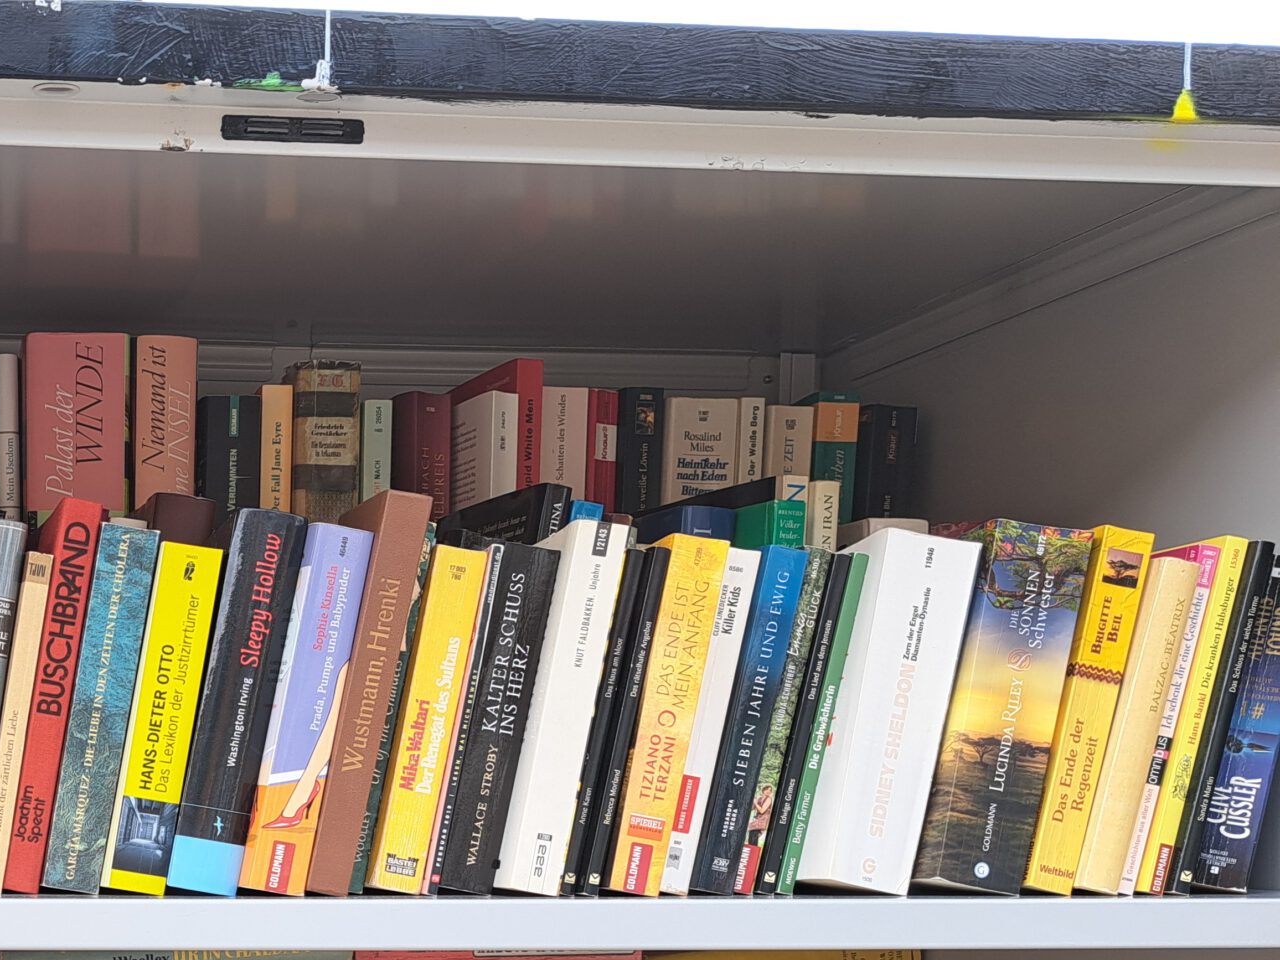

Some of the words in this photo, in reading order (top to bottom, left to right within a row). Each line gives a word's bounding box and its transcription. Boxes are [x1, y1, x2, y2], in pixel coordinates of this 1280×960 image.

[143, 345, 166, 365] ist
[45, 384, 74, 424] der
[75, 342, 103, 464] WINDE
[141, 369, 167, 472] Niemand
[5, 438, 14, 478] Usedom
[684, 431, 721, 442] Rosalind
[690, 442, 714, 452] Miles
[45, 428, 74, 497] Palast
[6, 479, 14, 502] Mein
[252, 533, 281, 603] Hollow
[37, 521, 90, 717] BUSCHBRAND
[172, 594, 200, 684] Justizirrtümer
[239, 609, 271, 667] Sleepy
[1090, 596, 1113, 654] BRIGITTE
[1106, 613, 1123, 642] BEIL
[482, 655, 510, 732] KALTER
[498, 572, 525, 647] SCHUSS
[506, 644, 530, 698] HERZ
[167, 689, 183, 710] der
[237, 678, 252, 706] Irving
[733, 724, 756, 786] SIEBEN
[747, 665, 770, 717] JAHRE
[760, 623, 778, 658] UND
[770, 571, 790, 615] EWIG
[1000, 678, 1023, 722] RILEY
[138, 689, 167, 790] HANS-DIETER
[157, 644, 174, 684] OTTO
[159, 715, 180, 764] Lexikon
[226, 708, 246, 767] Washington
[499, 703, 518, 736] INS
[811, 685, 836, 751] Grabwächterin
[1068, 718, 1085, 743] der
[154, 768, 171, 793] Das
[639, 734, 661, 799] TIZIANO
[652, 735, 676, 801] TERZANI
[808, 754, 821, 769] Die
[989, 726, 1016, 792] LUCINDA
[1059, 748, 1079, 788] Ende
[1071, 736, 1098, 812] Regenzeit
[466, 802, 488, 866] WALLACE
[480, 744, 499, 796] STROBY
[797, 791, 811, 820] Farmer
[1052, 793, 1068, 823] Das
[1208, 786, 1230, 823] CLIVE
[1219, 776, 1261, 839] CUSSLER
[792, 822, 806, 844] Betty
[268, 844, 285, 888] GOLDMANN
